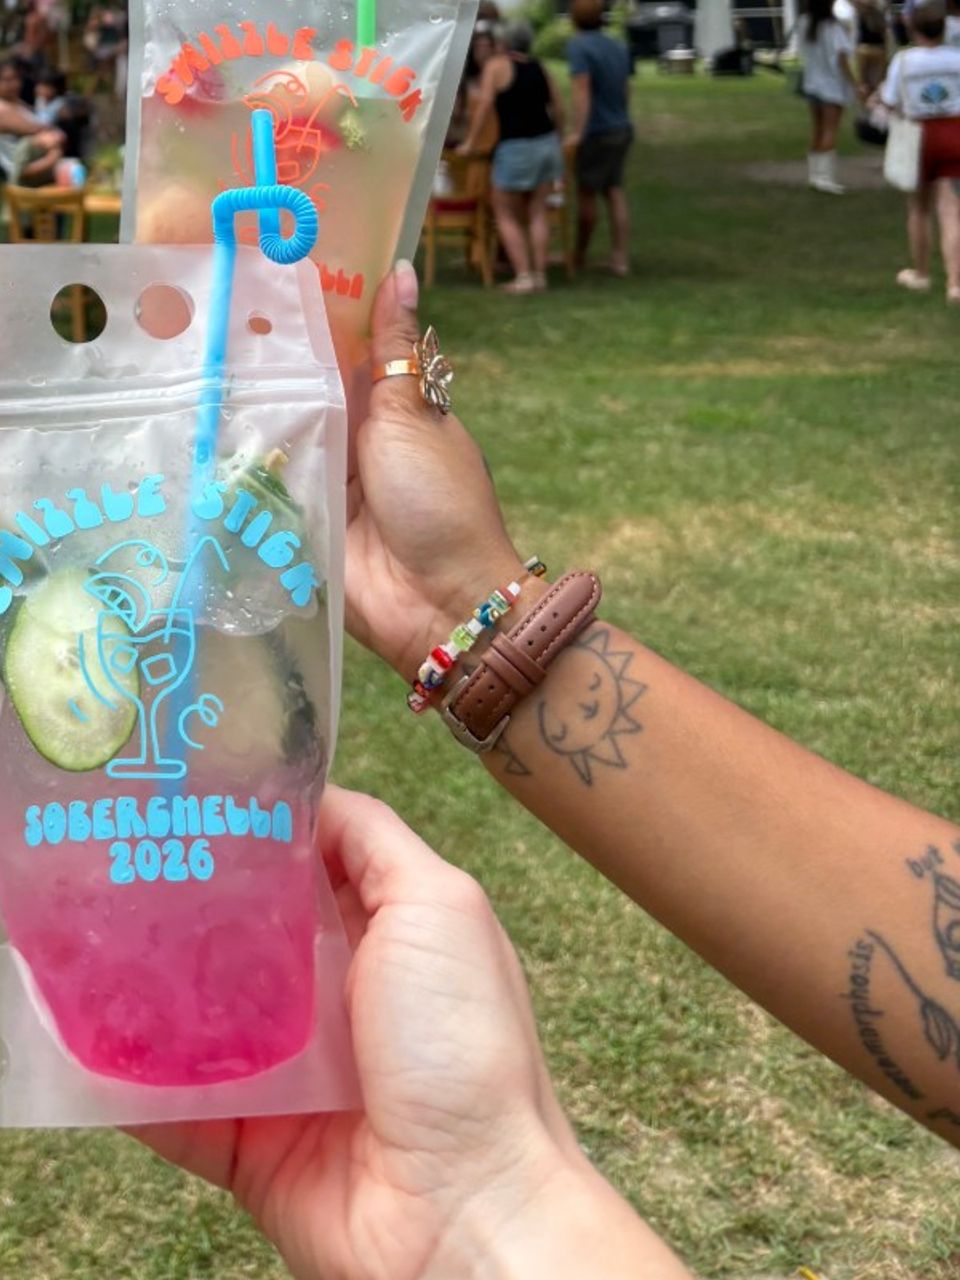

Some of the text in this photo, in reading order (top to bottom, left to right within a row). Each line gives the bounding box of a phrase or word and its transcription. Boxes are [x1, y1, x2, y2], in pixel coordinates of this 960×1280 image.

[155, 21, 423, 123] SWIZZLE STICK
[191, 480, 318, 608] STICK
[24, 794, 294, 847] SOBERCHELLA
[108, 838, 215, 885] 2026
